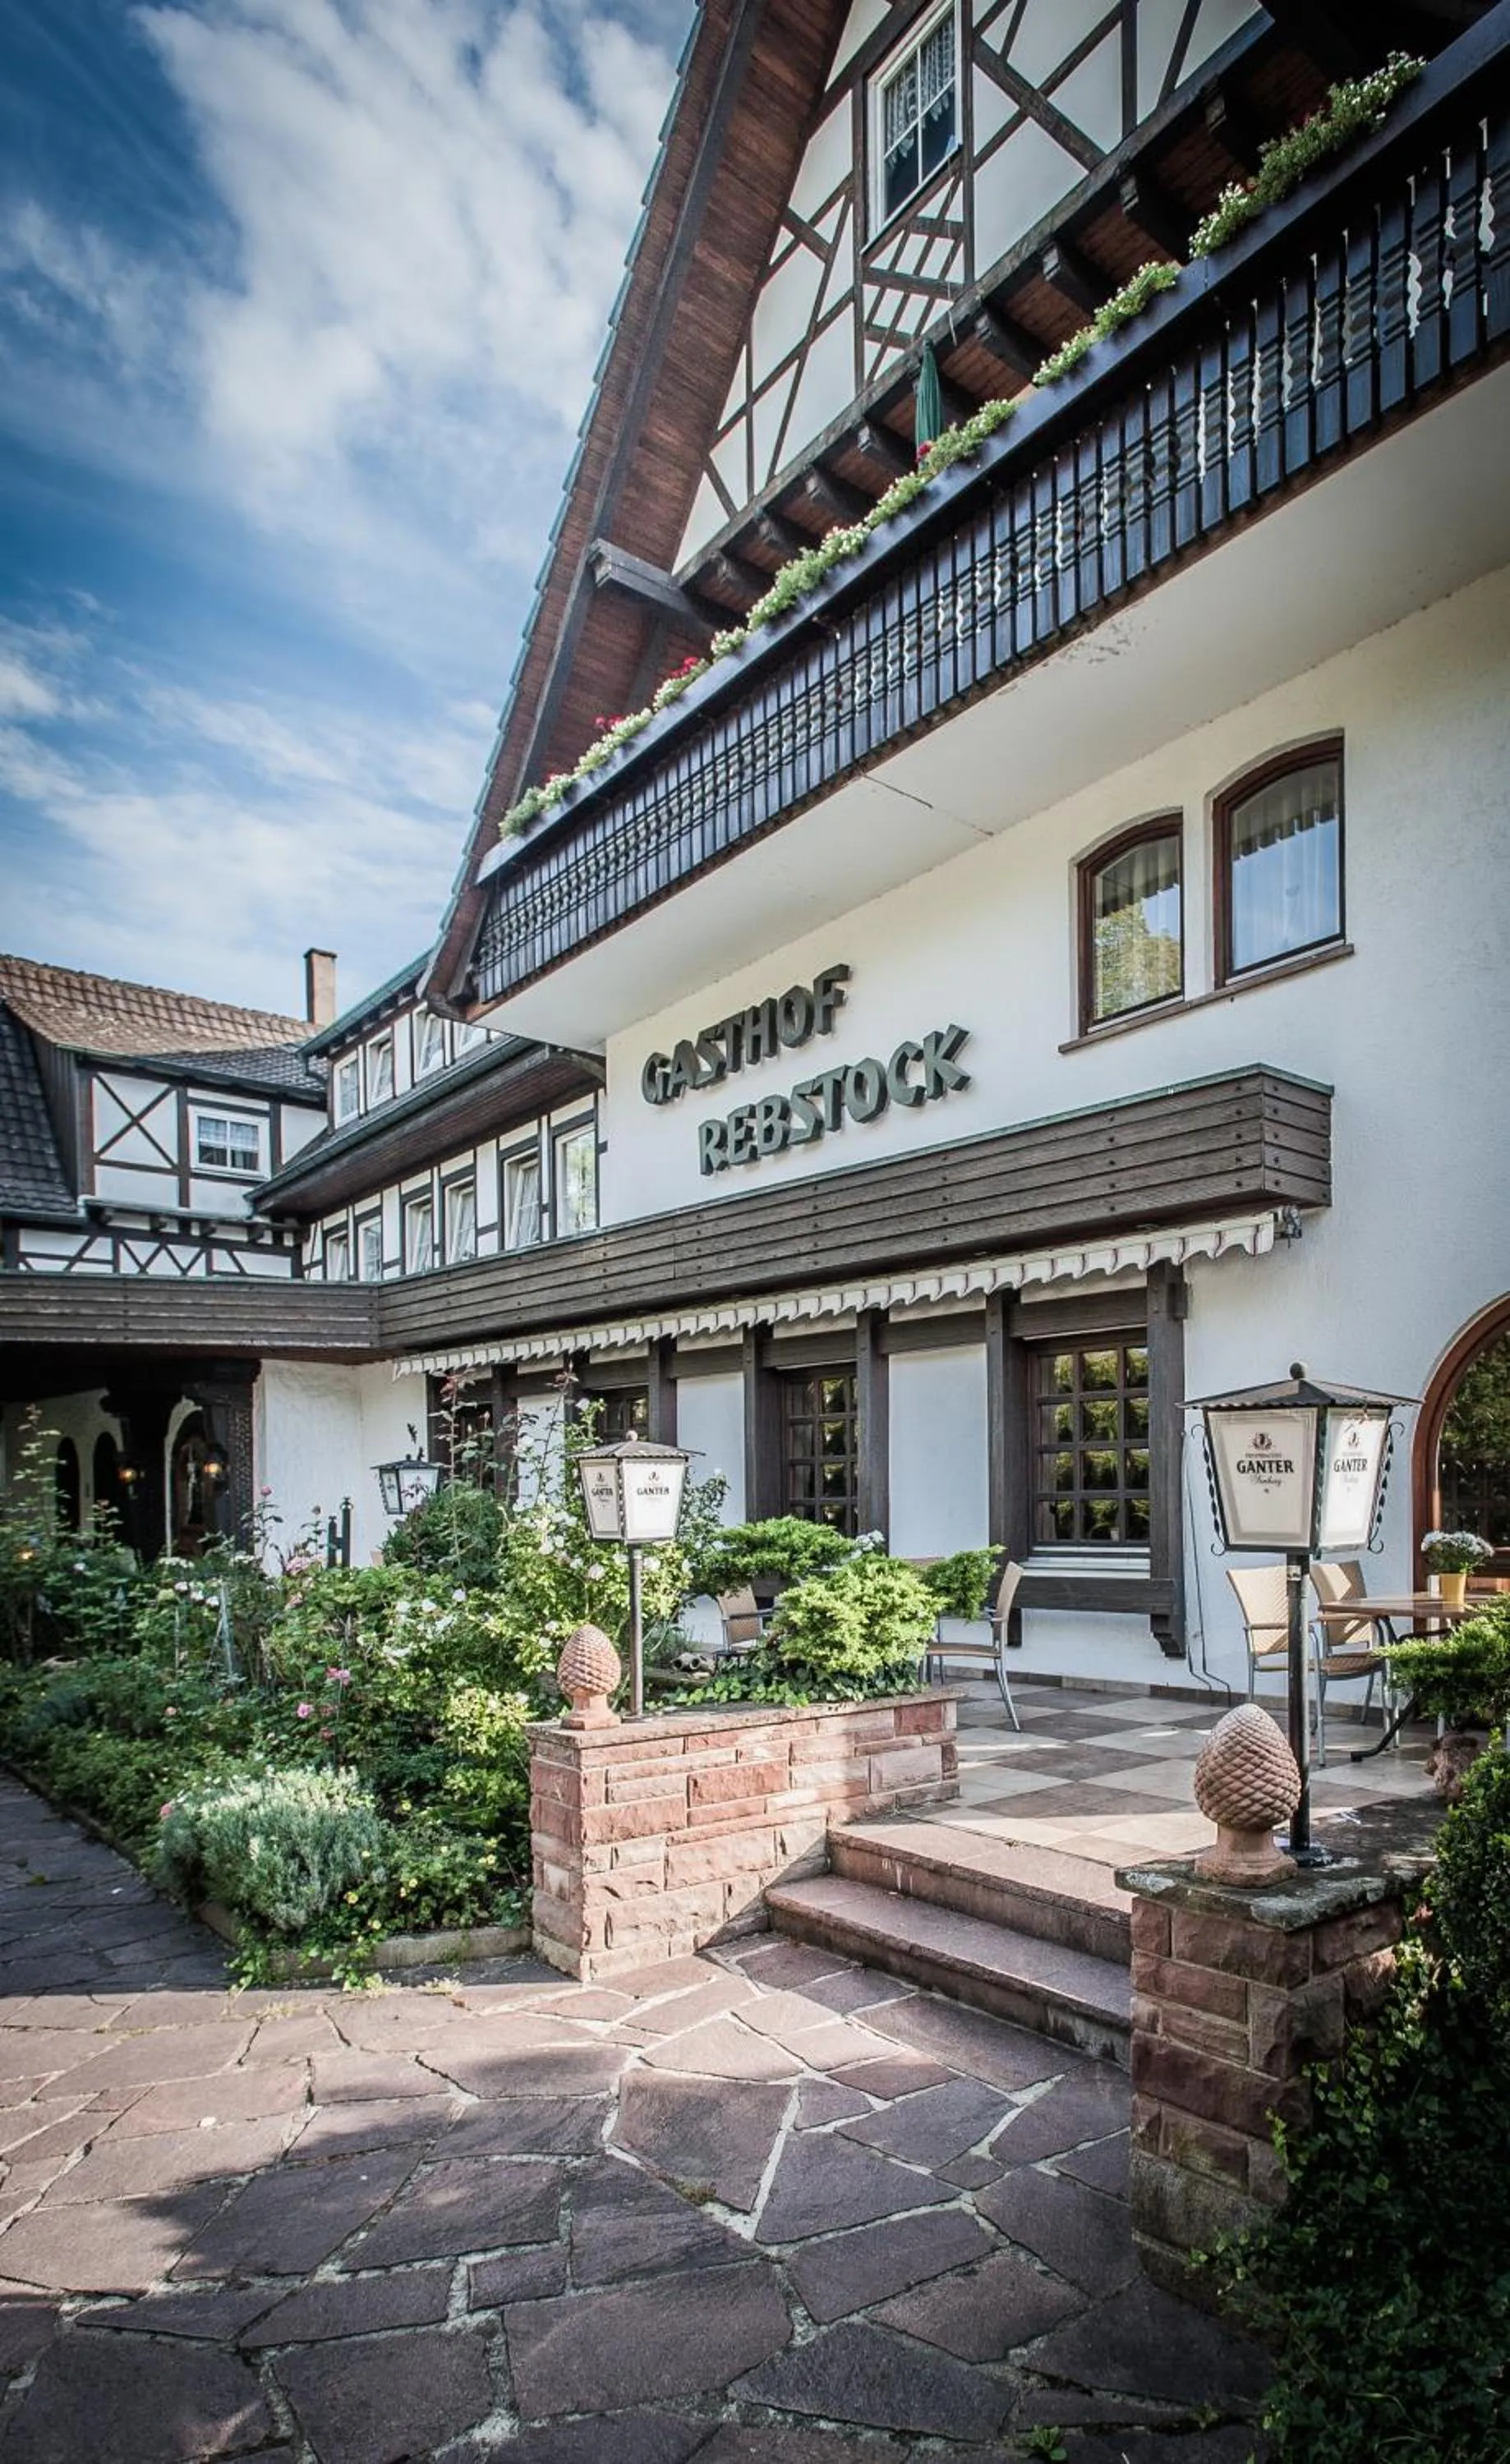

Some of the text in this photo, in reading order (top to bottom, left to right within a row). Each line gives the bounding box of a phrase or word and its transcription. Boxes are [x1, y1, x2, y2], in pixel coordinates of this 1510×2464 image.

[642, 963, 852, 1106] GASTHOF
[697, 1023, 972, 1176] REBSTOCK
[1236, 1460, 1294, 1473] GANTER
[1333, 1458, 1368, 1472] GANTER
